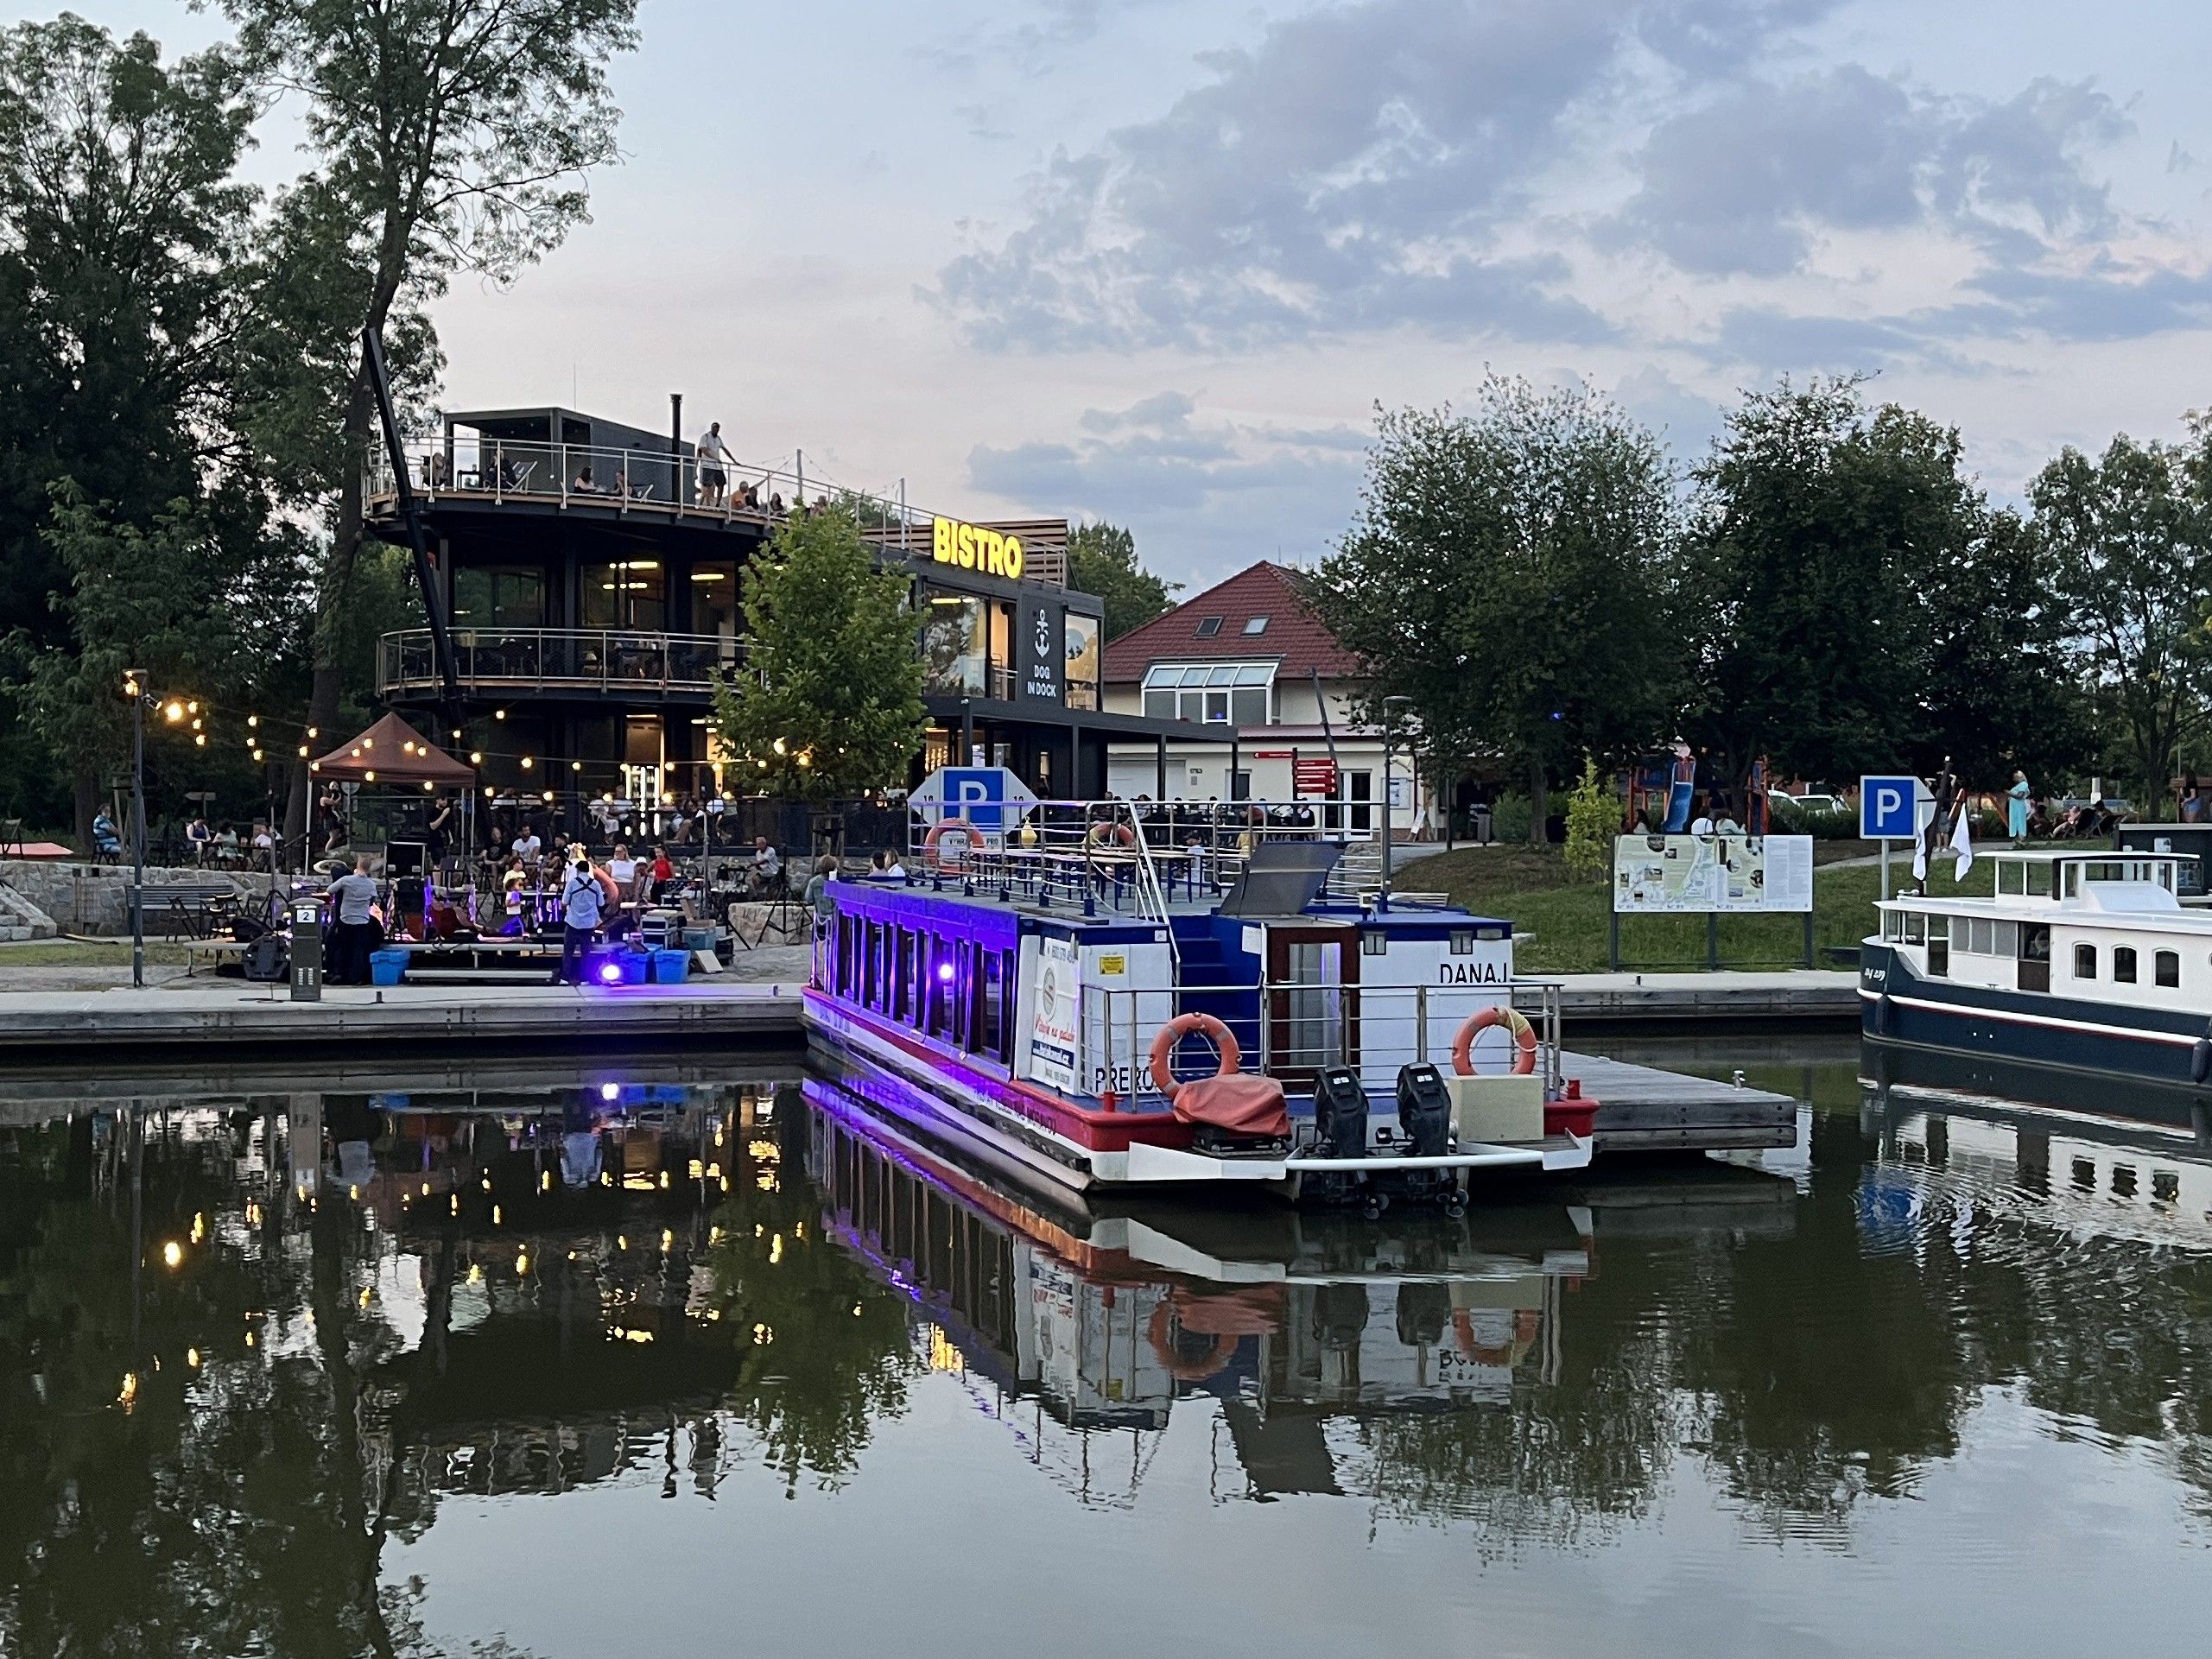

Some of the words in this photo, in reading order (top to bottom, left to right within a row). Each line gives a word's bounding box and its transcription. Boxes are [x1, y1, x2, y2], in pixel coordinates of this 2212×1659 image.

[933, 516, 1023, 579] BISTRO
[1034, 664, 1050, 680] DOG
[1027, 681, 1036, 694] IN
[1036, 681, 1057, 697] DOCK
[959, 780, 988, 821] P
[1877, 788, 1901, 827] P
[302, 911, 309, 921] 2
[1095, 1061, 1154, 1092] PŘERO
